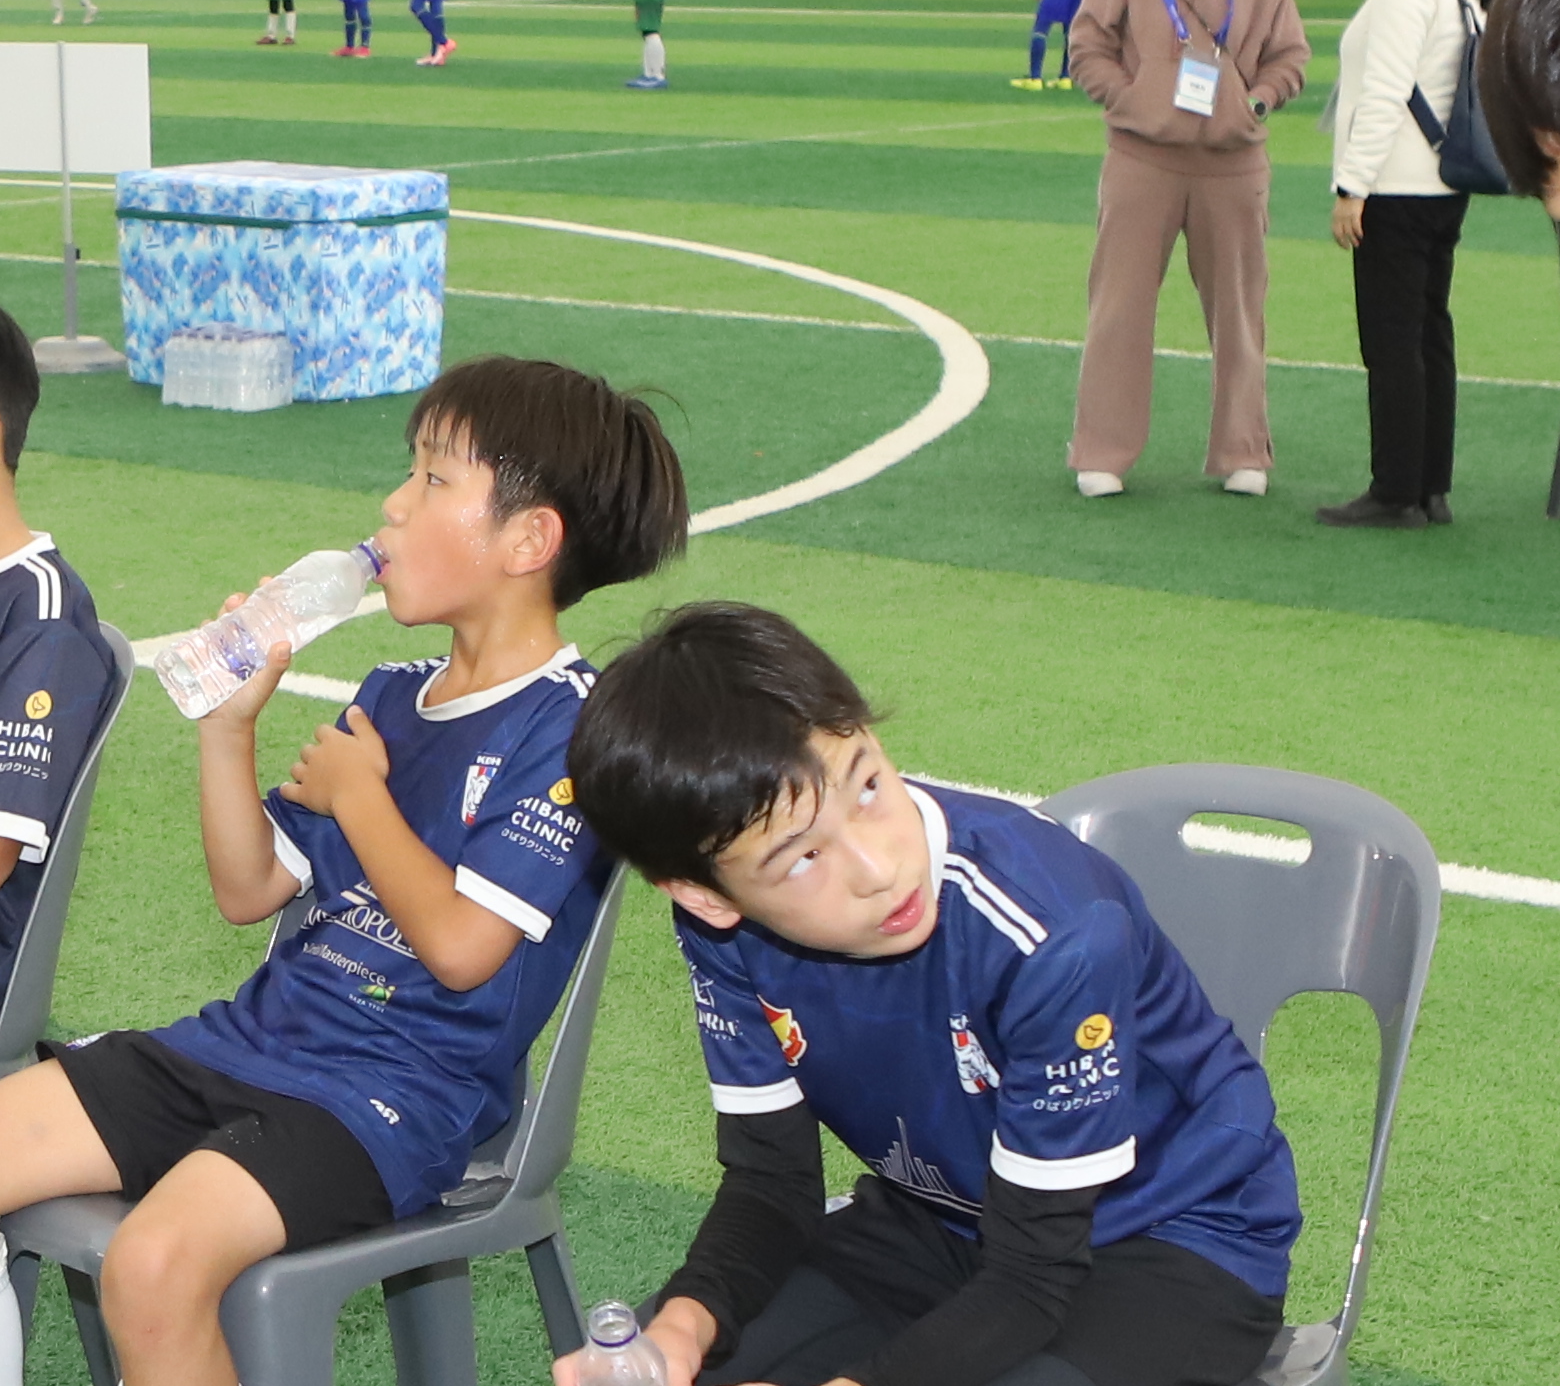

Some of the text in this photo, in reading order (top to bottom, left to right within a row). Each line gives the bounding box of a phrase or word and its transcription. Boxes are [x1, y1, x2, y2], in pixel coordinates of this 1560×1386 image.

[476, 755, 502, 766] KDH
[511, 811, 575, 852] CLINIC
[516, 796, 582, 835] HIBARI
